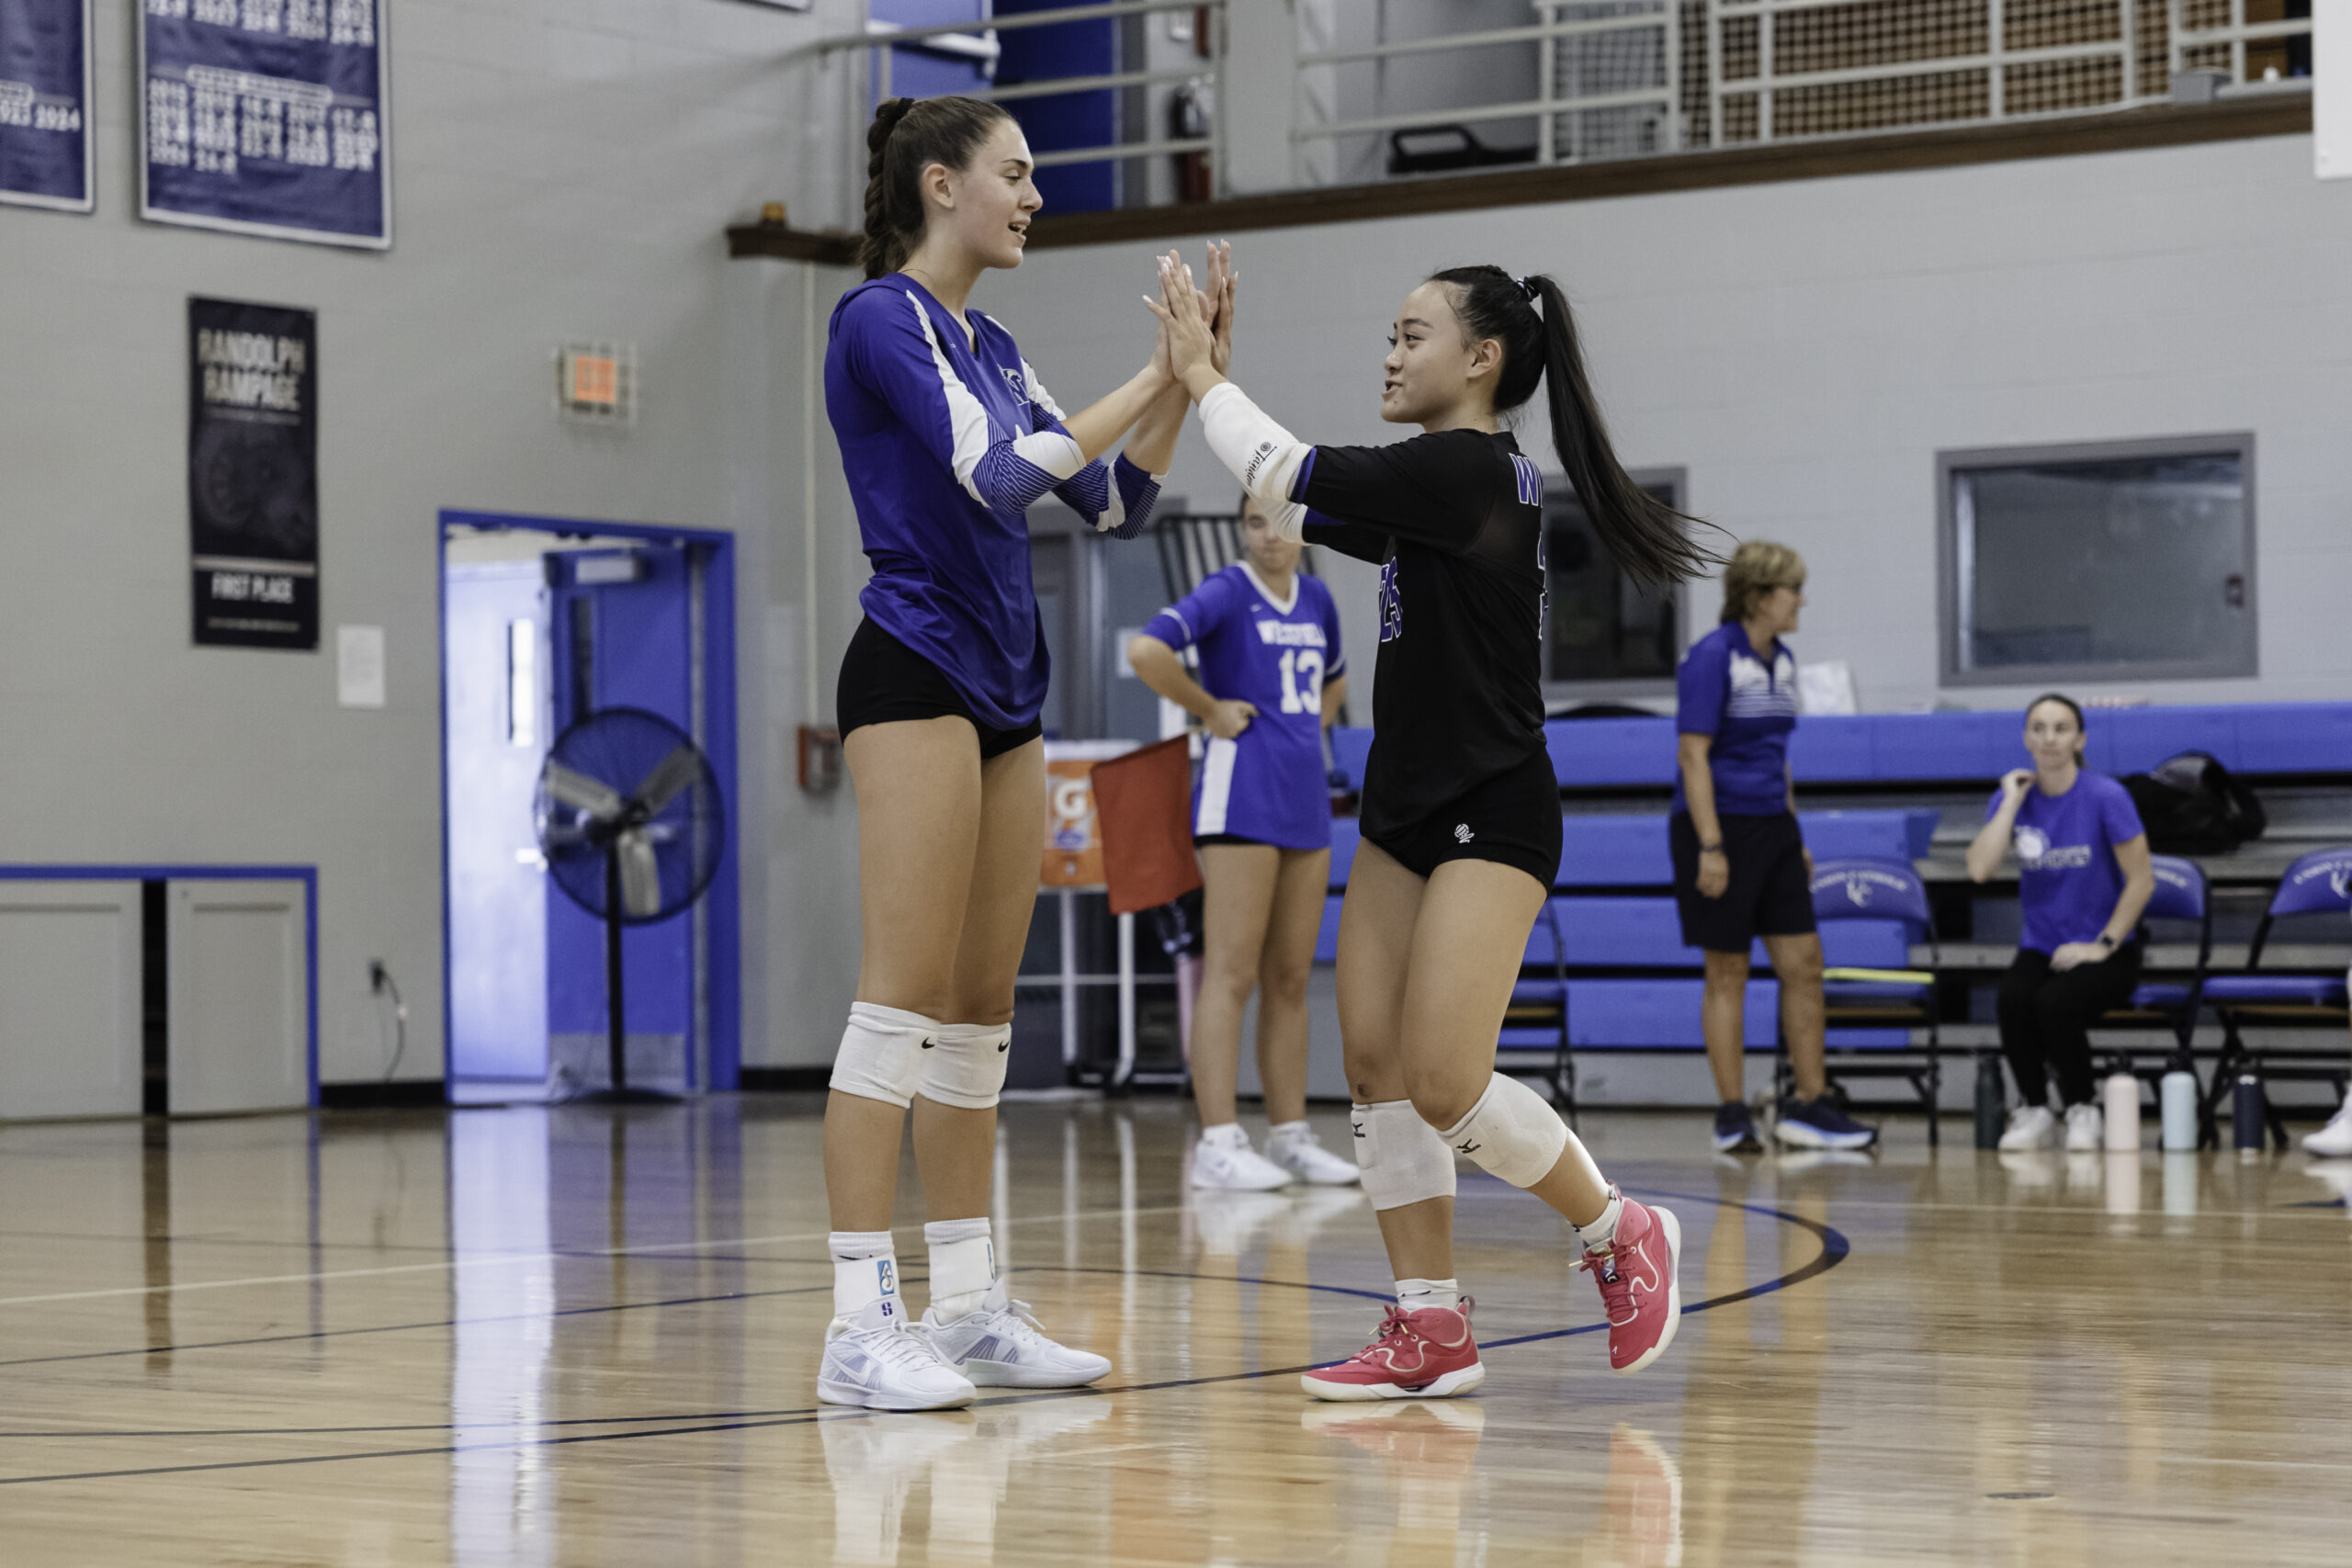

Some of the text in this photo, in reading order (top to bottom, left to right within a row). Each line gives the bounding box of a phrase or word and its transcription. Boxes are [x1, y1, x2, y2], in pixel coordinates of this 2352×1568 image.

[204, 367, 301, 412] RAMPAGE
[211, 571, 294, 604] FIRST PLACE
[1379, 556, 1404, 642] 25
[1279, 649, 1325, 715] 13
[1055, 778, 1090, 819] G
